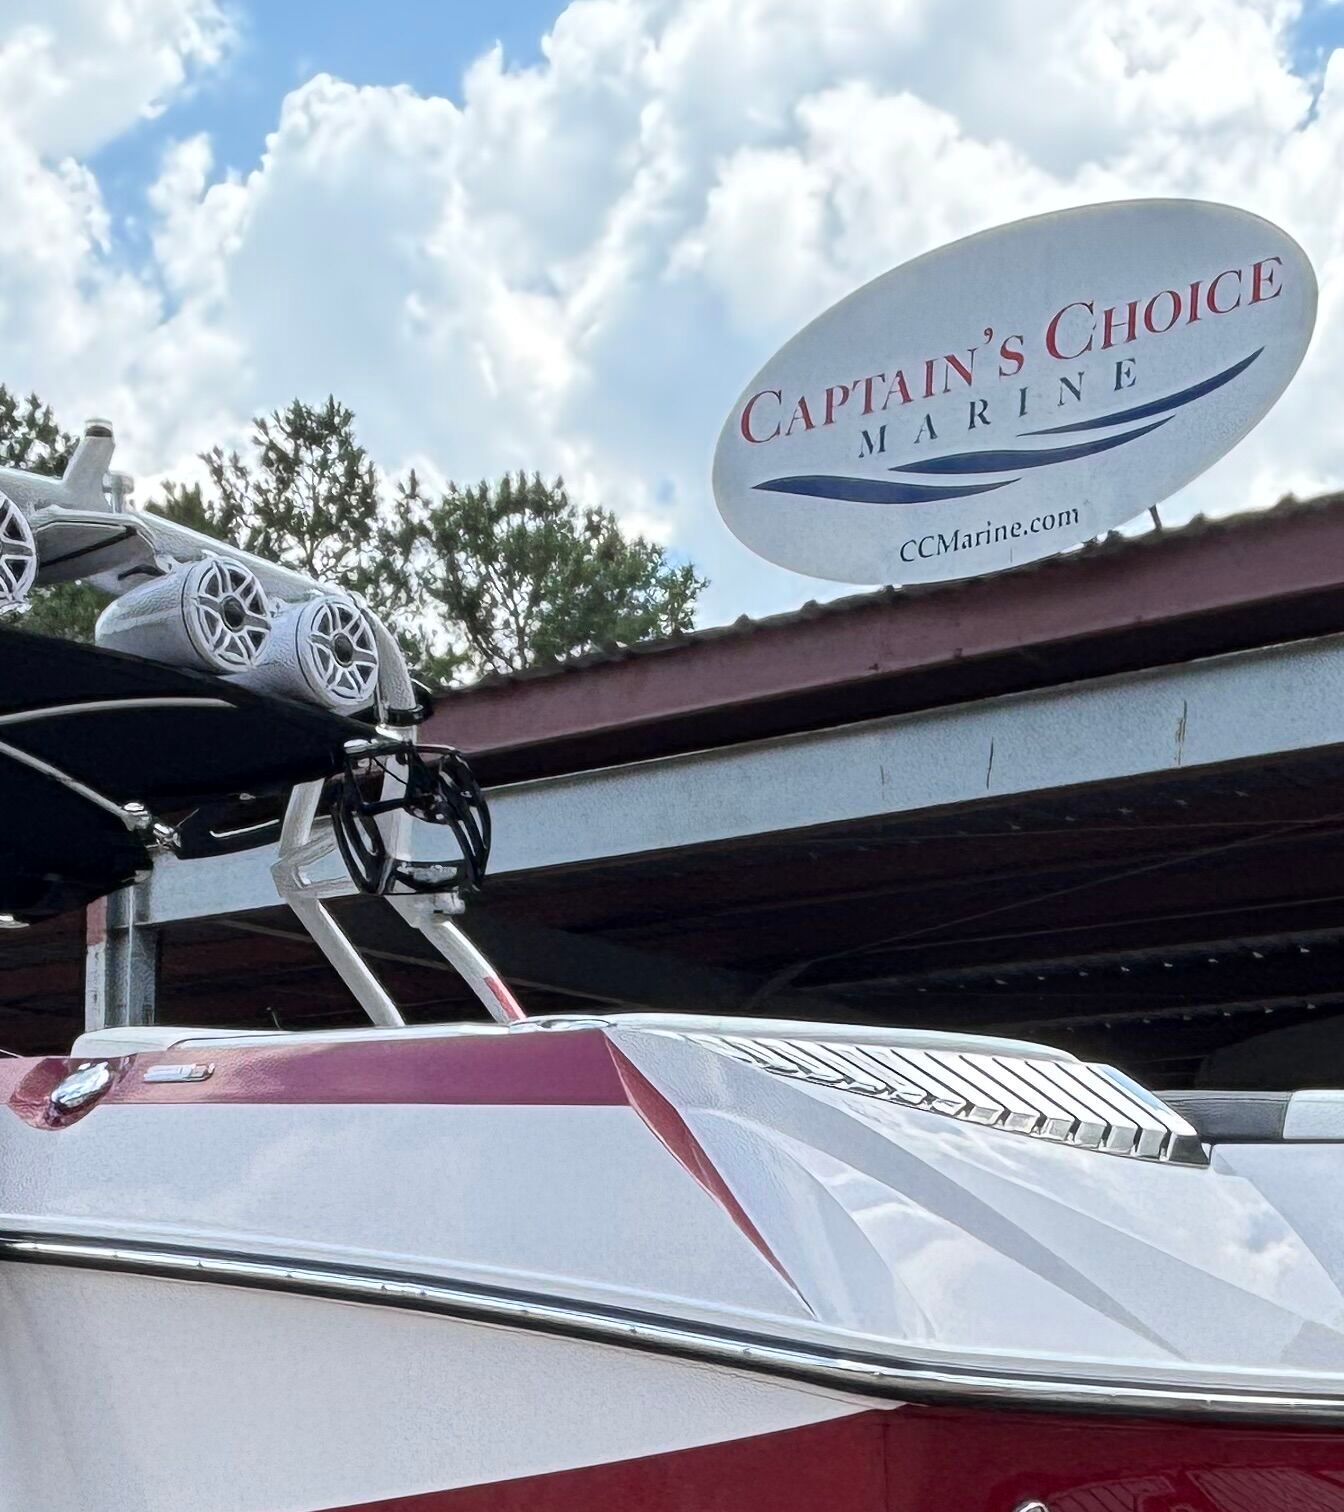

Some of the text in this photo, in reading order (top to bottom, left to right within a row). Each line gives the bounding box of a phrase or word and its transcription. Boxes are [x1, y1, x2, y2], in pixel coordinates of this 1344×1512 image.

[740, 256, 1283, 443] CAPTAIN'S CHOICE
[858, 357, 1137, 459] MARINE
[899, 507, 1080, 563] CCMarine.com
